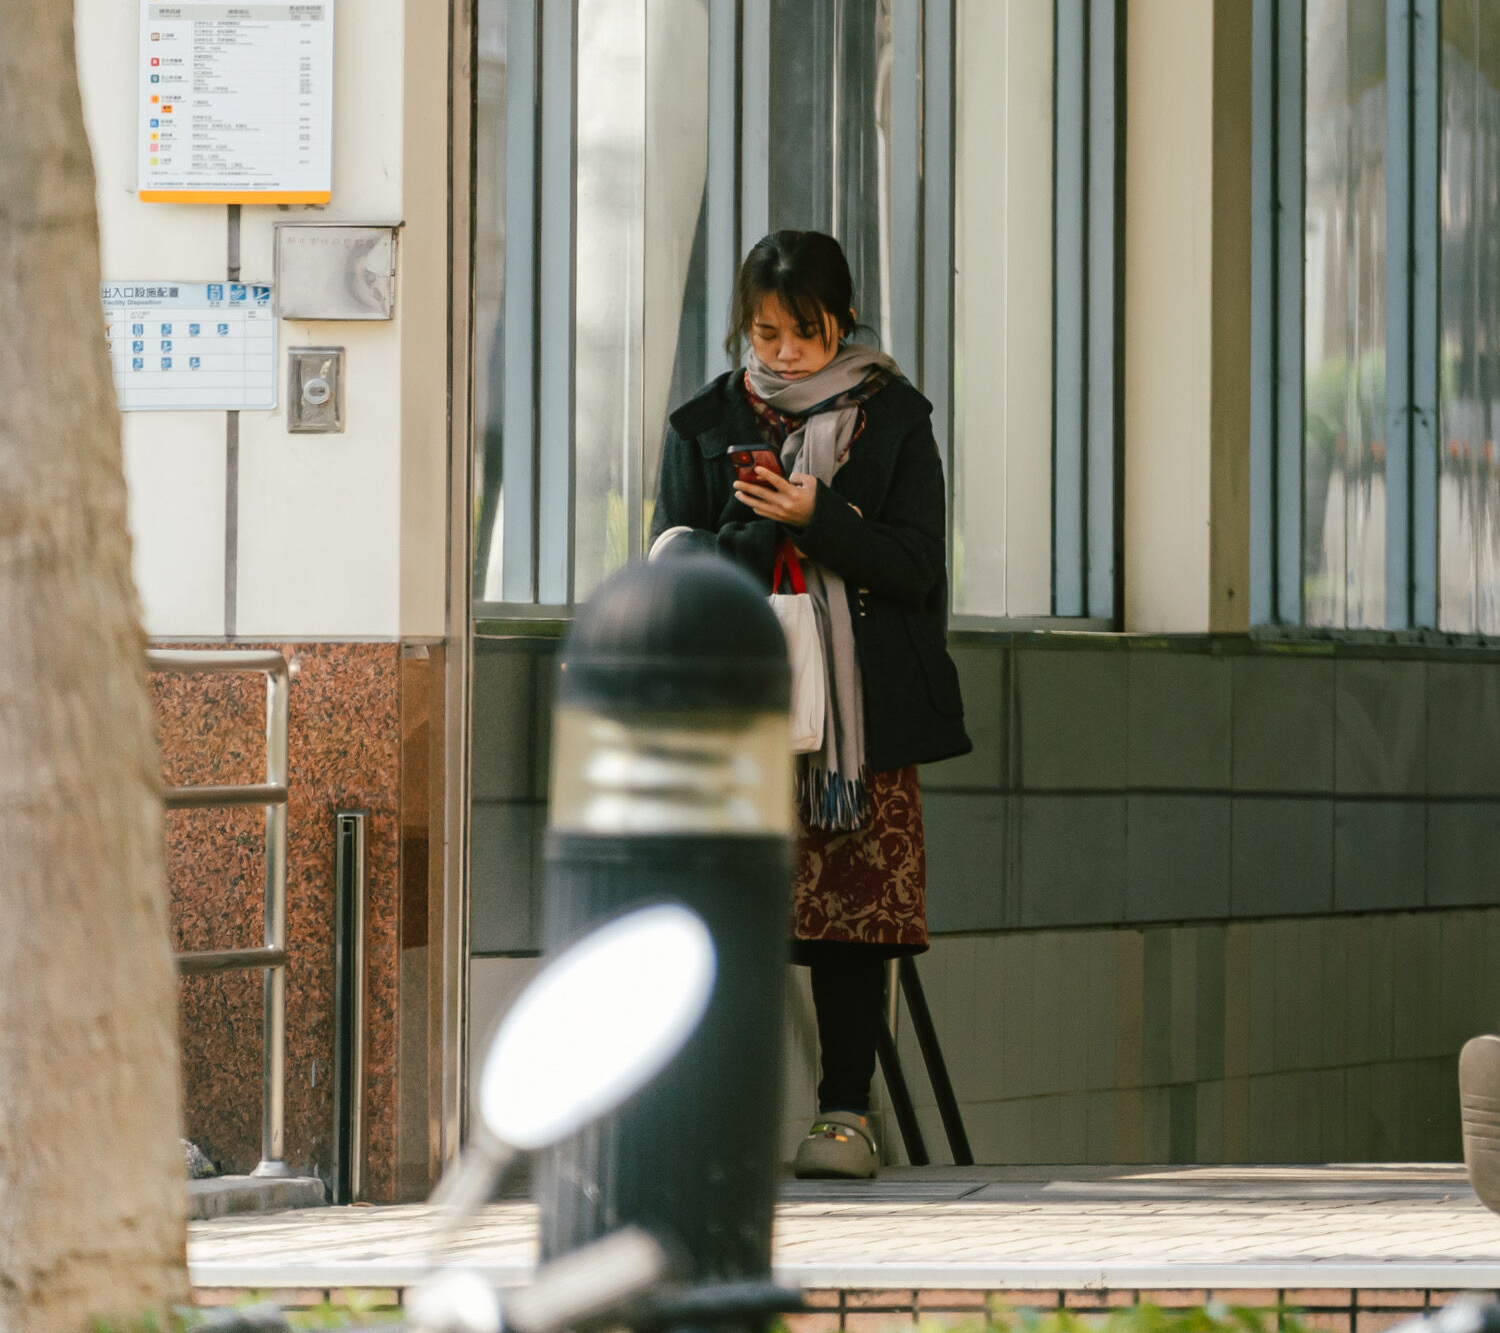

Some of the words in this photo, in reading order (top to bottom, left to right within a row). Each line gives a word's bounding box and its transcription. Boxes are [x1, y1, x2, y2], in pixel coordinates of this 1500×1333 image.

[102, 287, 179, 298] 出入口設施配置
